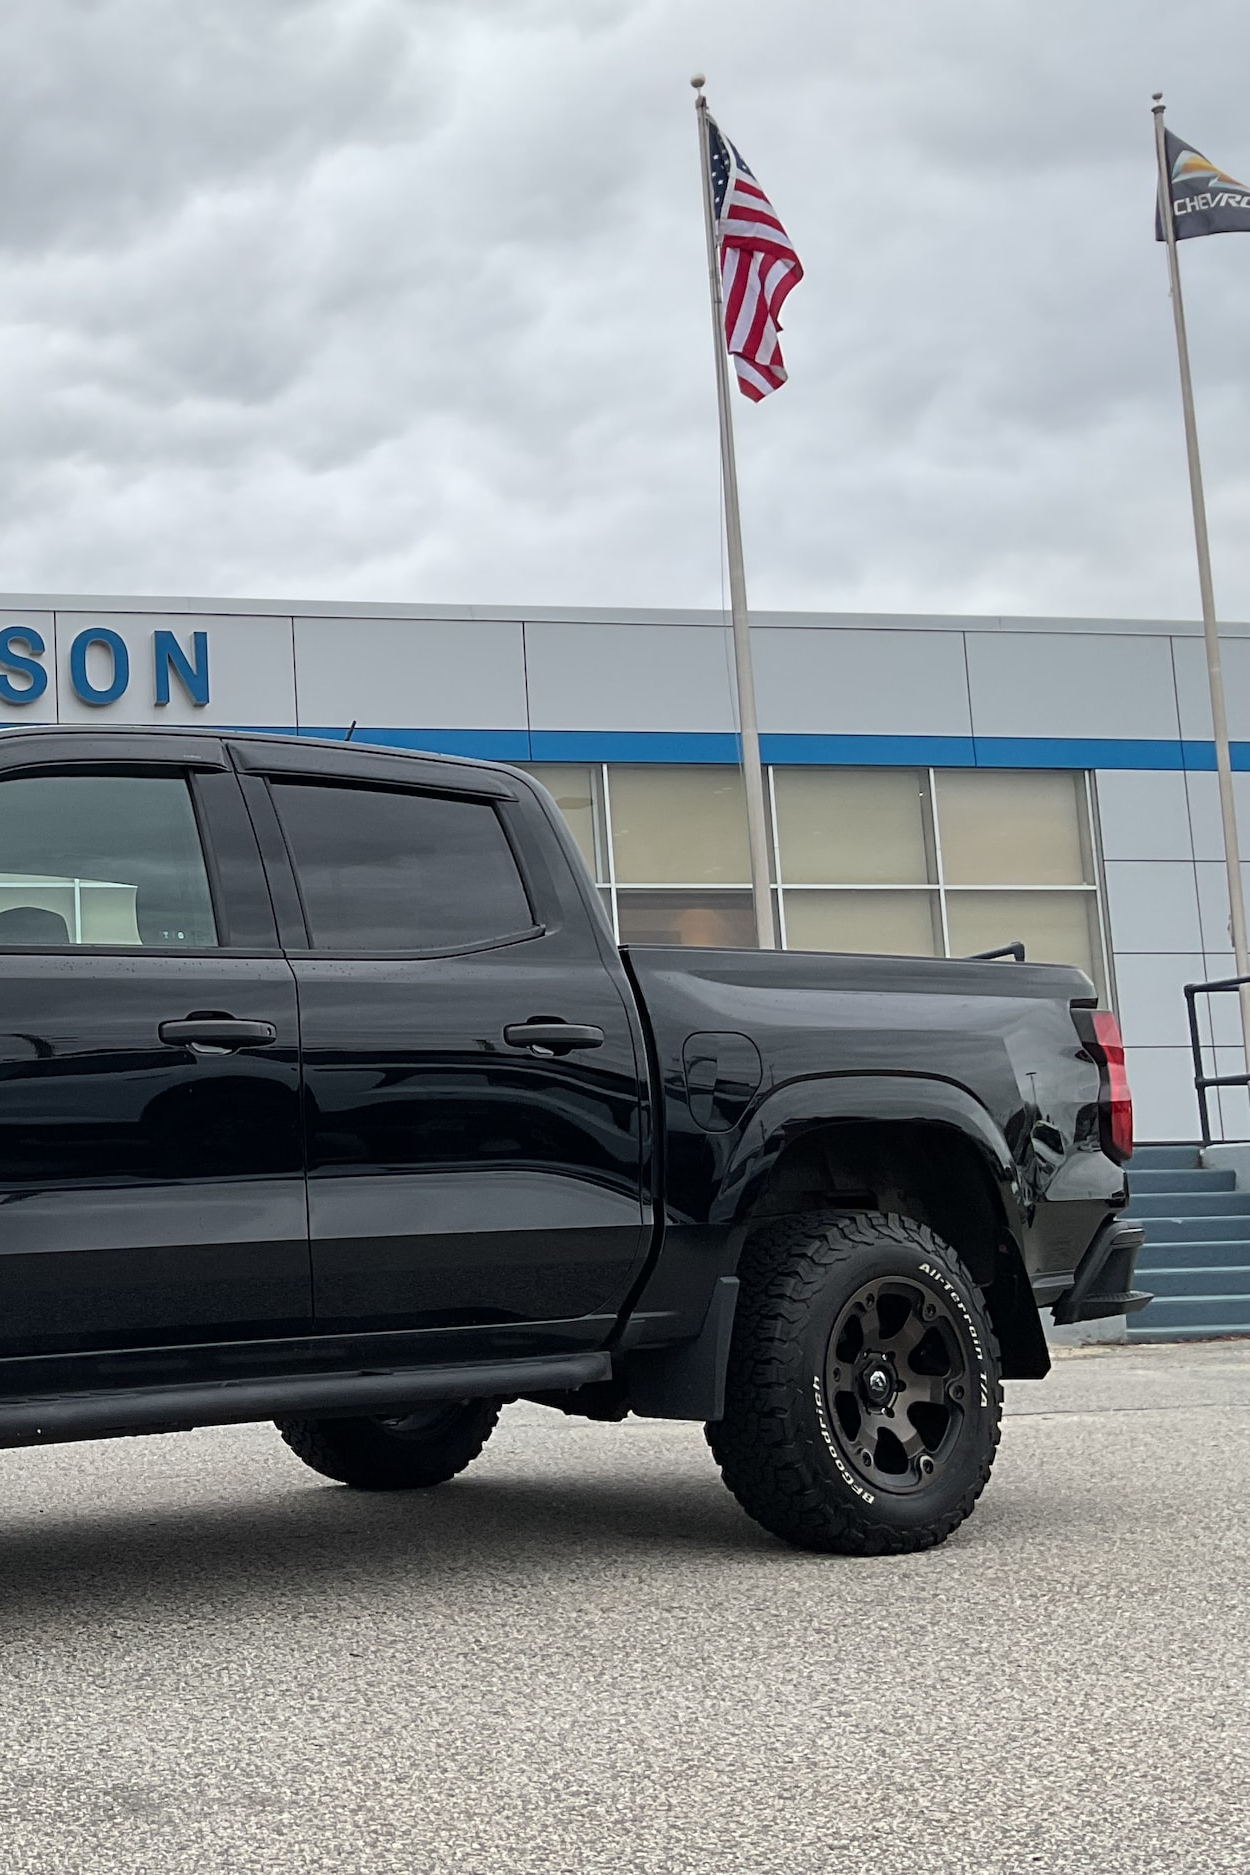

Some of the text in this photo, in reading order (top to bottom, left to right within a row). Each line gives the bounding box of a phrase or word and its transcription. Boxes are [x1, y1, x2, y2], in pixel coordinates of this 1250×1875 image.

[918, 1263, 988, 1408] All-Terrain T/A
[813, 1376, 875, 1504] BFGoodrich
